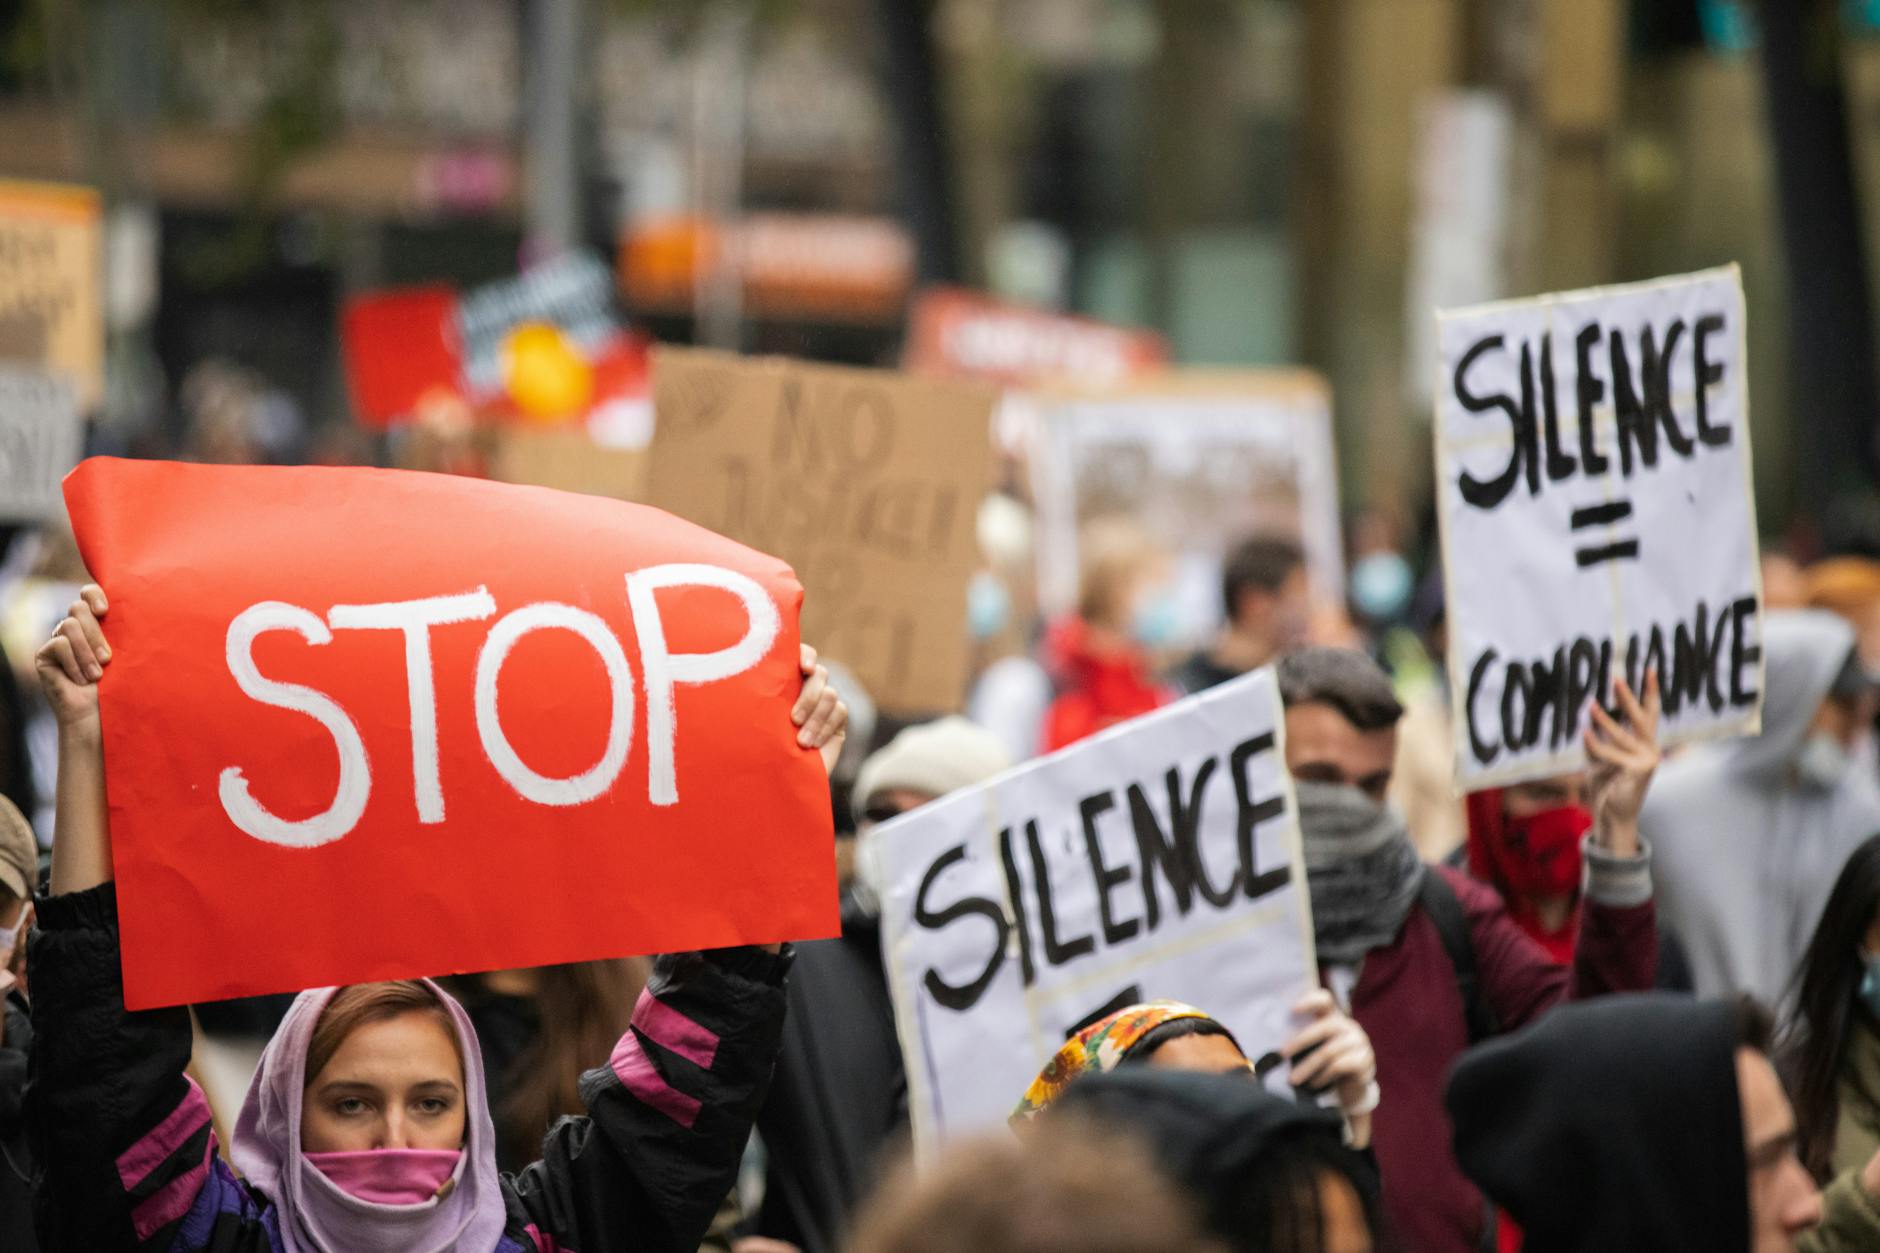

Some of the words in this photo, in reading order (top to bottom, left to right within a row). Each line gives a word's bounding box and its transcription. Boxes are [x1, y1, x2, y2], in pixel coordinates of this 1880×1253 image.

[1454, 313, 1732, 509] SILENCE
[1570, 500, 1638, 567] =
[219, 563, 781, 849] STOP
[1466, 597, 1762, 765] COMPLIANCE
[914, 731, 1291, 1011] SILENCE
